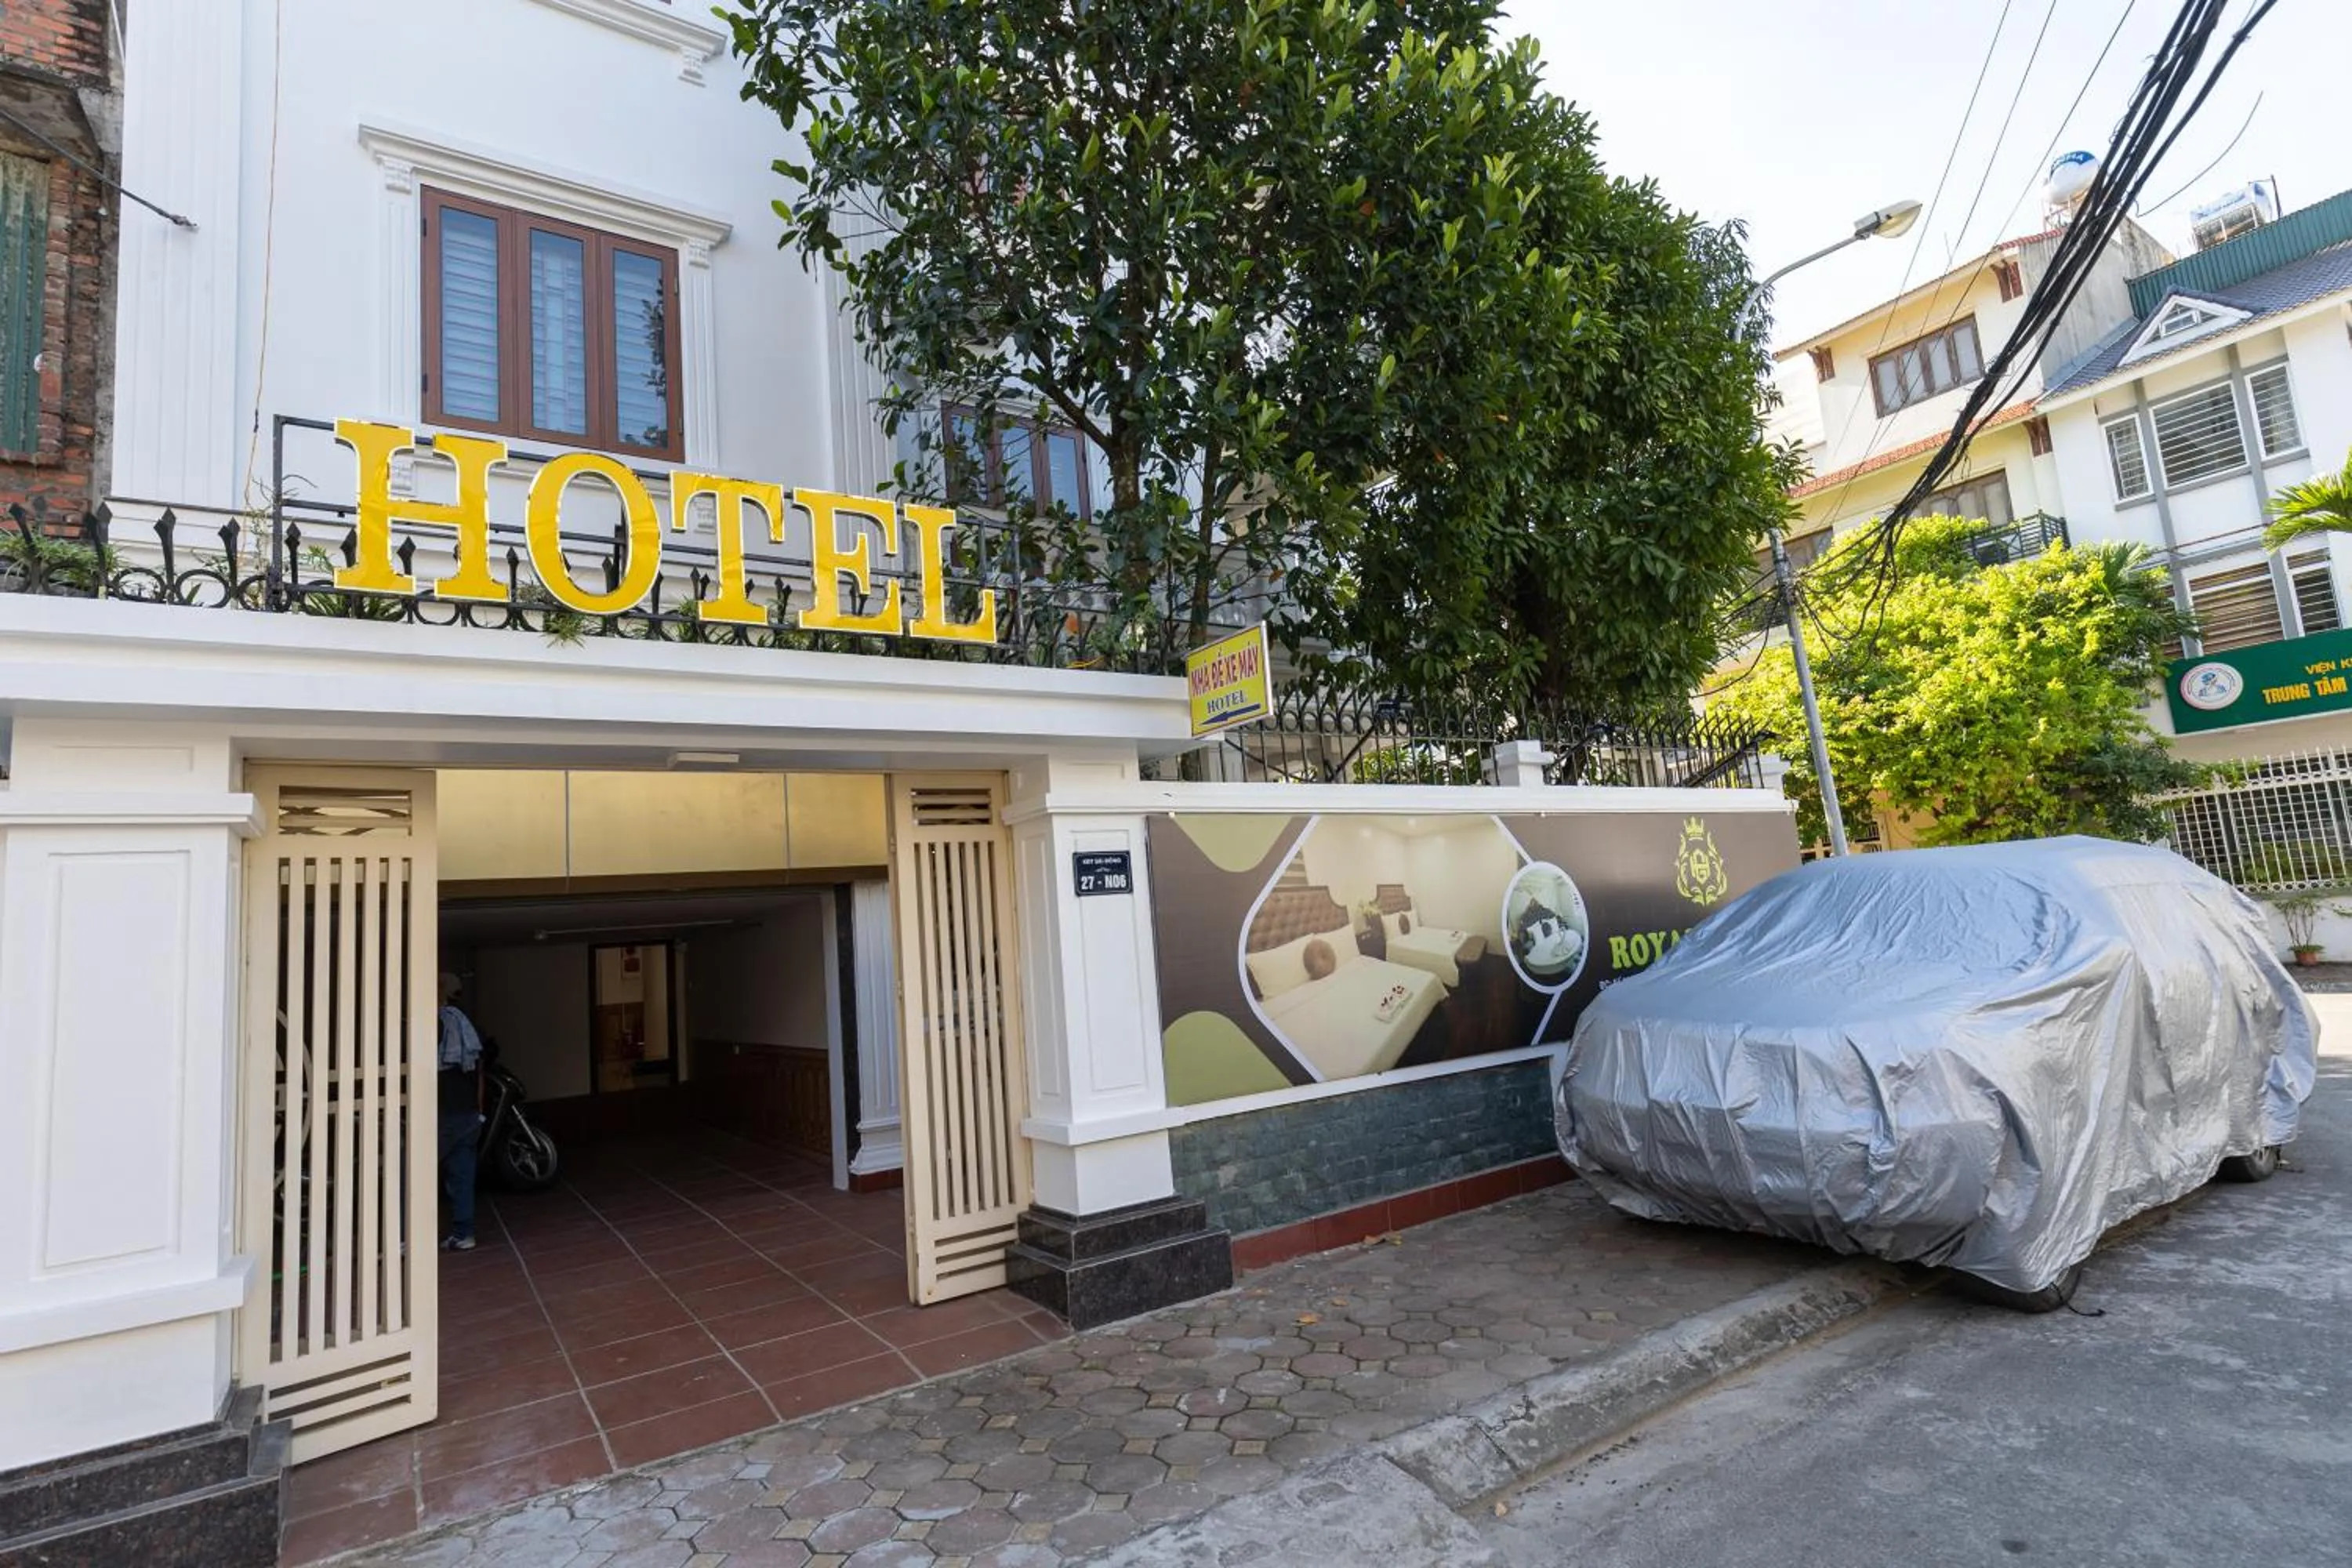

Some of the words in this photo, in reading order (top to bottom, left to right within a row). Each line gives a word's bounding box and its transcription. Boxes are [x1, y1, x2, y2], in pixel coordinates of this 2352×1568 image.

[334, 418, 998, 644] HOTEL
[1224, 653, 1238, 685] XE
[1238, 640, 1259, 681] MÁY
[2305, 660, 2336, 676] VIỆN
[1207, 689, 1247, 714] HOTEL
[2262, 683, 2311, 705] TRUNG
[2314, 677, 2348, 696] TÂM
[1081, 875, 1094, 891] 27
[1608, 928, 1693, 970] ROY
